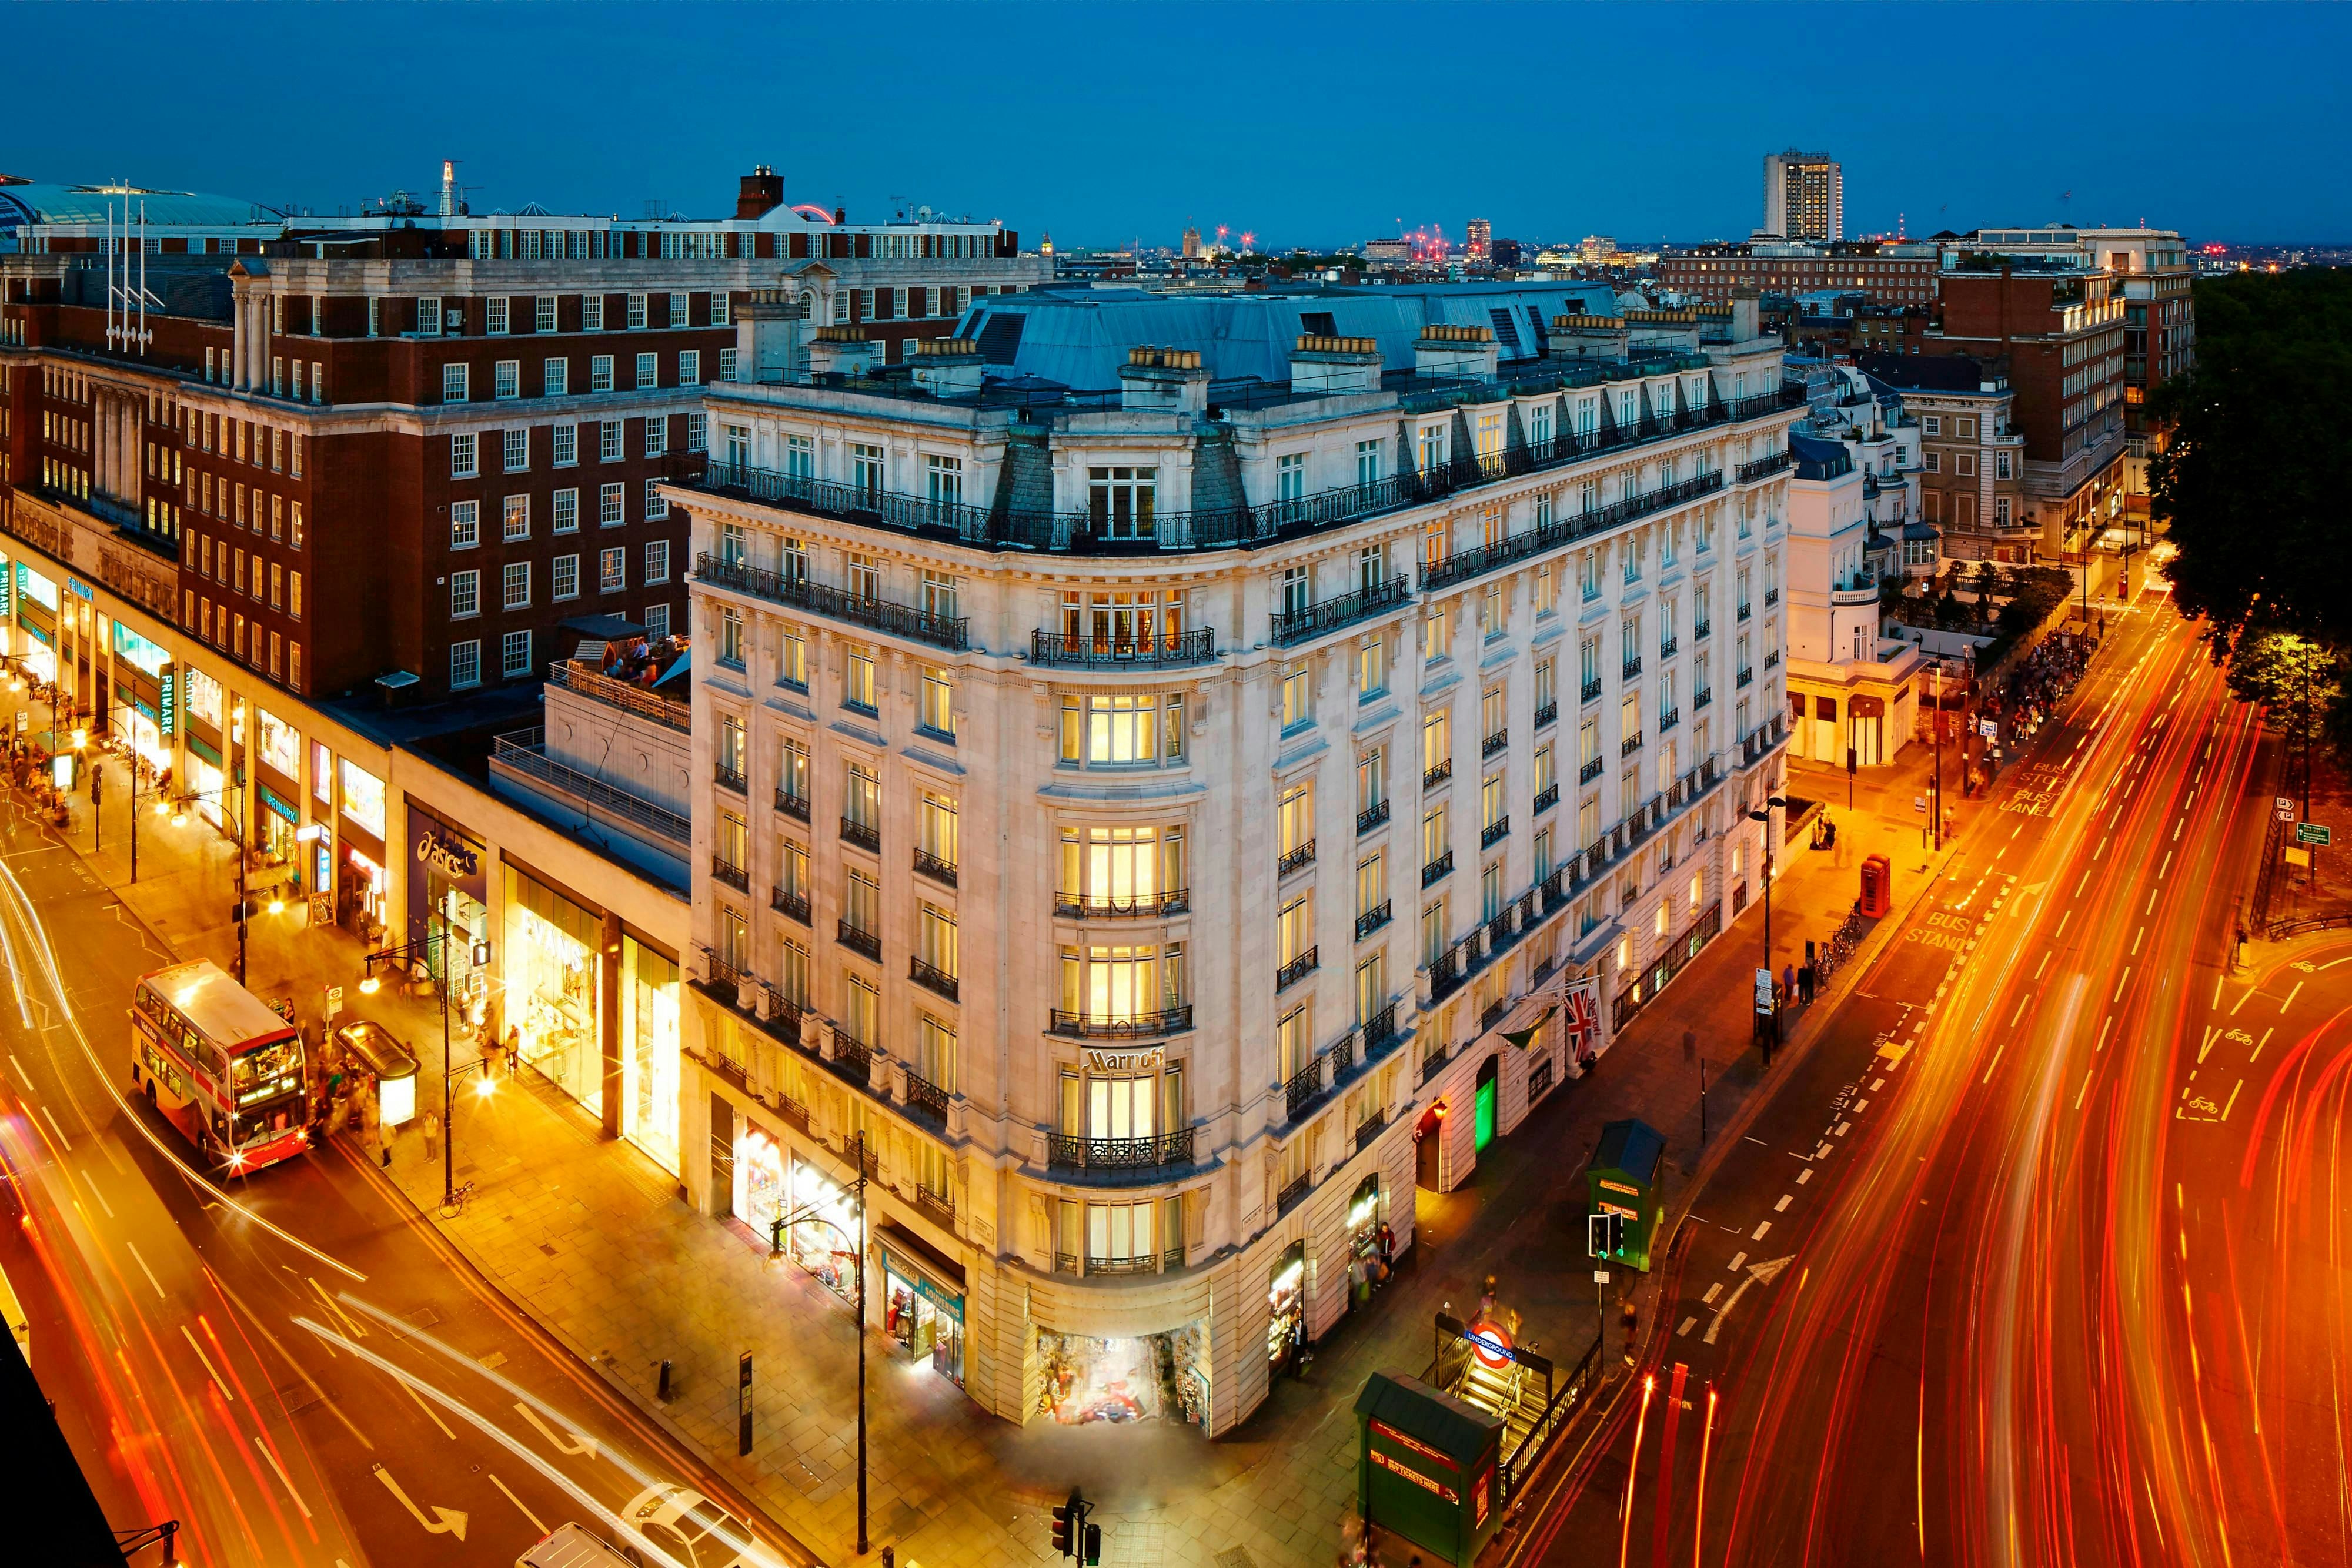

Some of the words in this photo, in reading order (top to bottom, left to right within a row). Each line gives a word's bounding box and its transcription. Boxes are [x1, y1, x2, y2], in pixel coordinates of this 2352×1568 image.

[0, 570, 9, 616] PRIMARK
[68, 576, 94, 603] PRIMARK
[162, 675, 172, 735] PRIMARK
[2020, 772, 2066, 784] STOP
[2033, 763, 2066, 774] BUS
[1999, 800, 2049, 817] LANE
[2013, 789, 2051, 803] BUS
[268, 795, 296, 823] PRIMARK
[1927, 911, 1970, 932] BUS
[520, 908, 584, 972] EVANS
[1905, 928, 1966, 952] STAND
[1872, 1032, 1889, 1047] ONLY
[1081, 1049, 1165, 1072] Marriott
[924, 1286, 960, 1318] SOUVENIRS
[1468, 1332, 1514, 1358] UNDERGROUND
[1388, 1462, 1399, 1472] BUY
[1399, 1466, 1423, 1485] TICKETS
[1424, 1480, 1439, 1493] HERE
